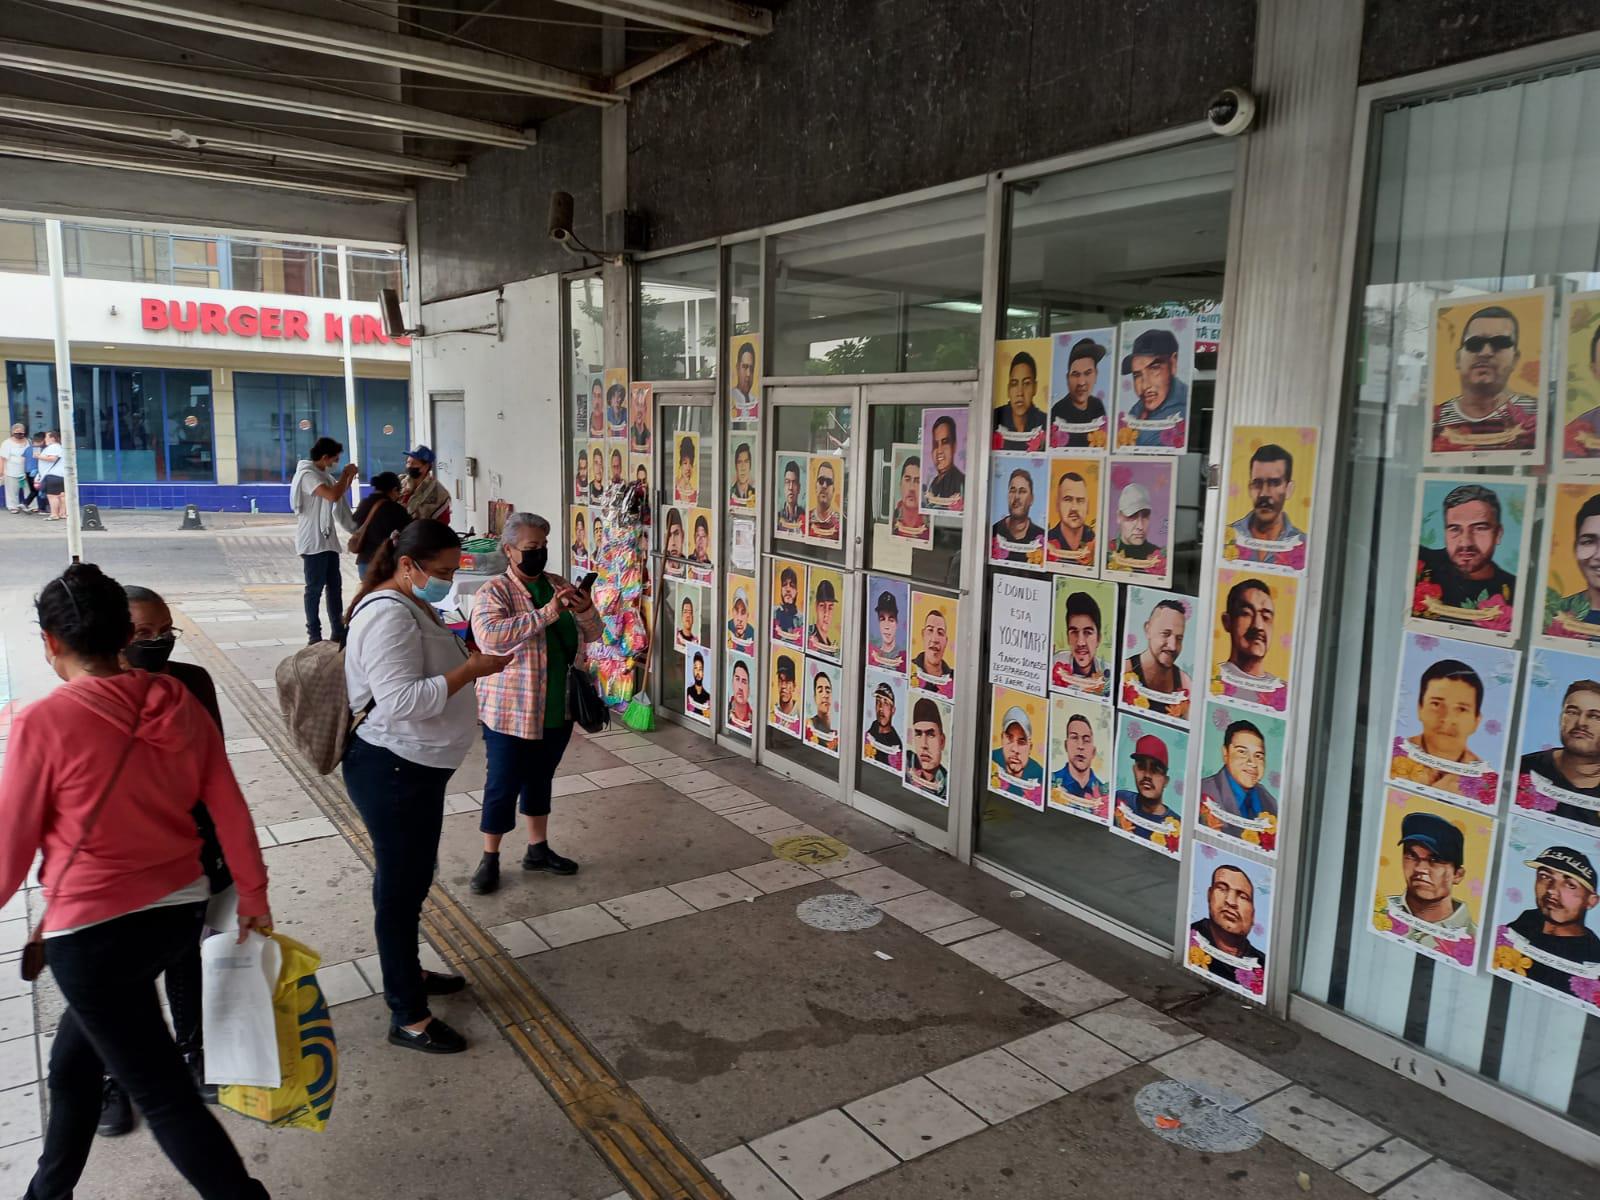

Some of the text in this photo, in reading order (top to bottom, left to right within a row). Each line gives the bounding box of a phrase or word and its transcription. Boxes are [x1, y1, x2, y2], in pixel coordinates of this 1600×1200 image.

[141, 297, 412, 347] BURGER KIN
[1010, 607, 1032, 623] ESTA
[999, 625, 1047, 653] YOSIMAR?
